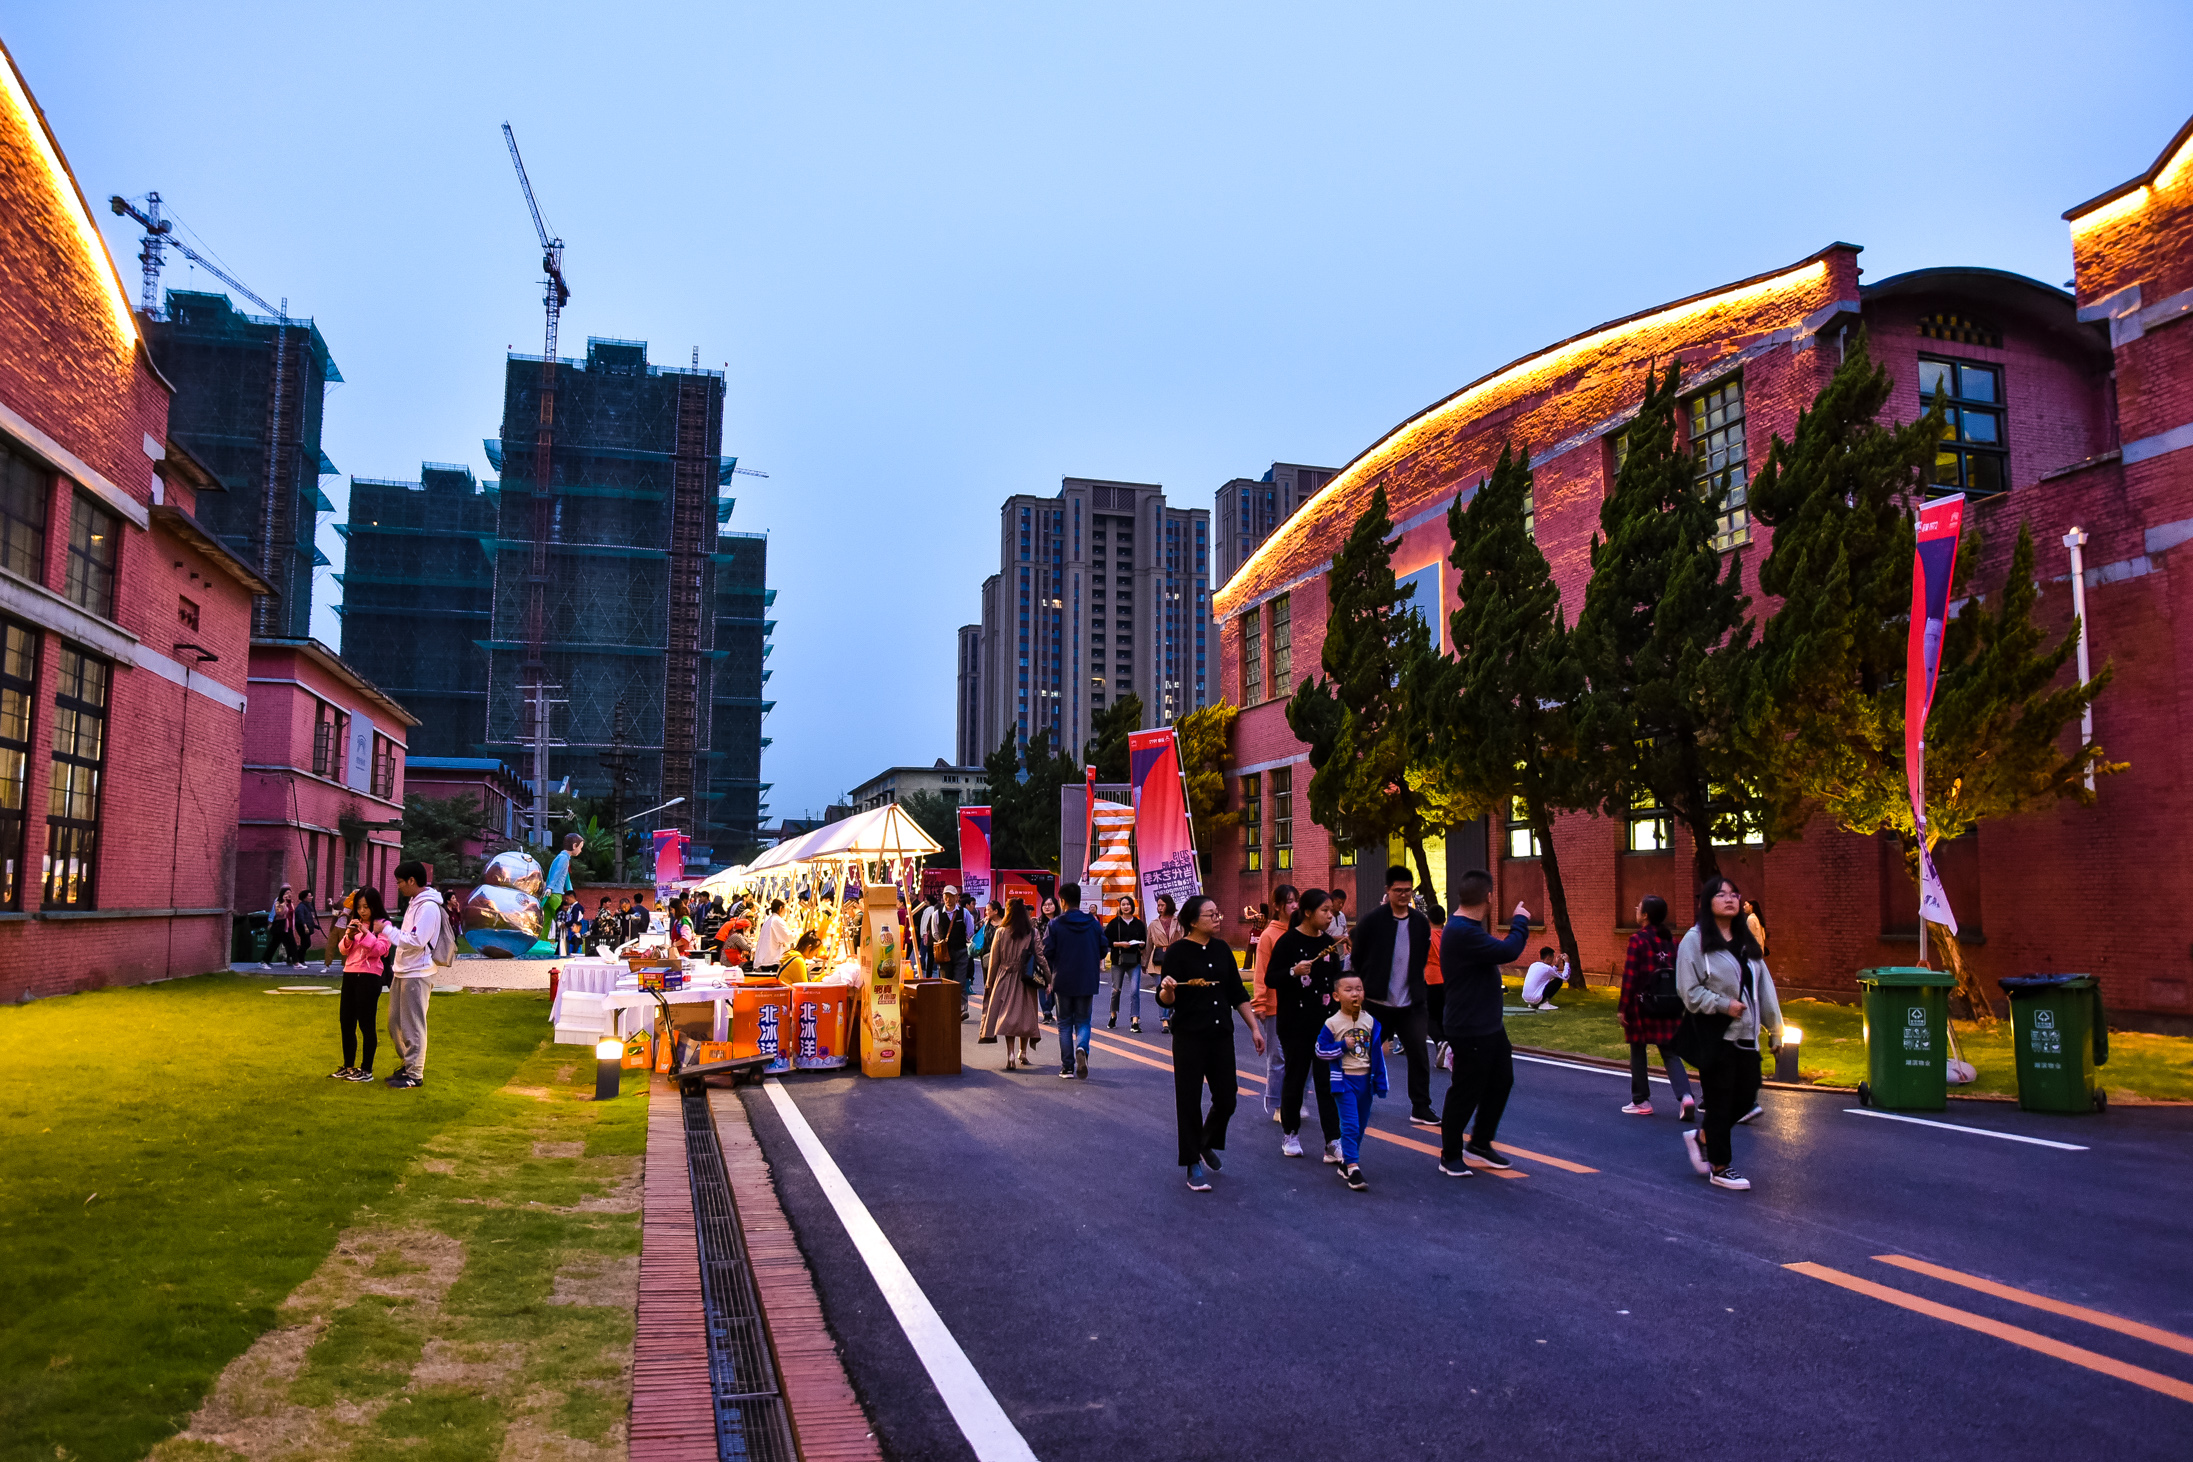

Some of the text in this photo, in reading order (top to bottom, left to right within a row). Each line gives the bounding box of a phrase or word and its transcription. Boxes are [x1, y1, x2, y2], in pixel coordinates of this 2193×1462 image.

[760, 1005, 778, 1057] 北冰洋
[800, 1003, 816, 1057] 北冰洋
